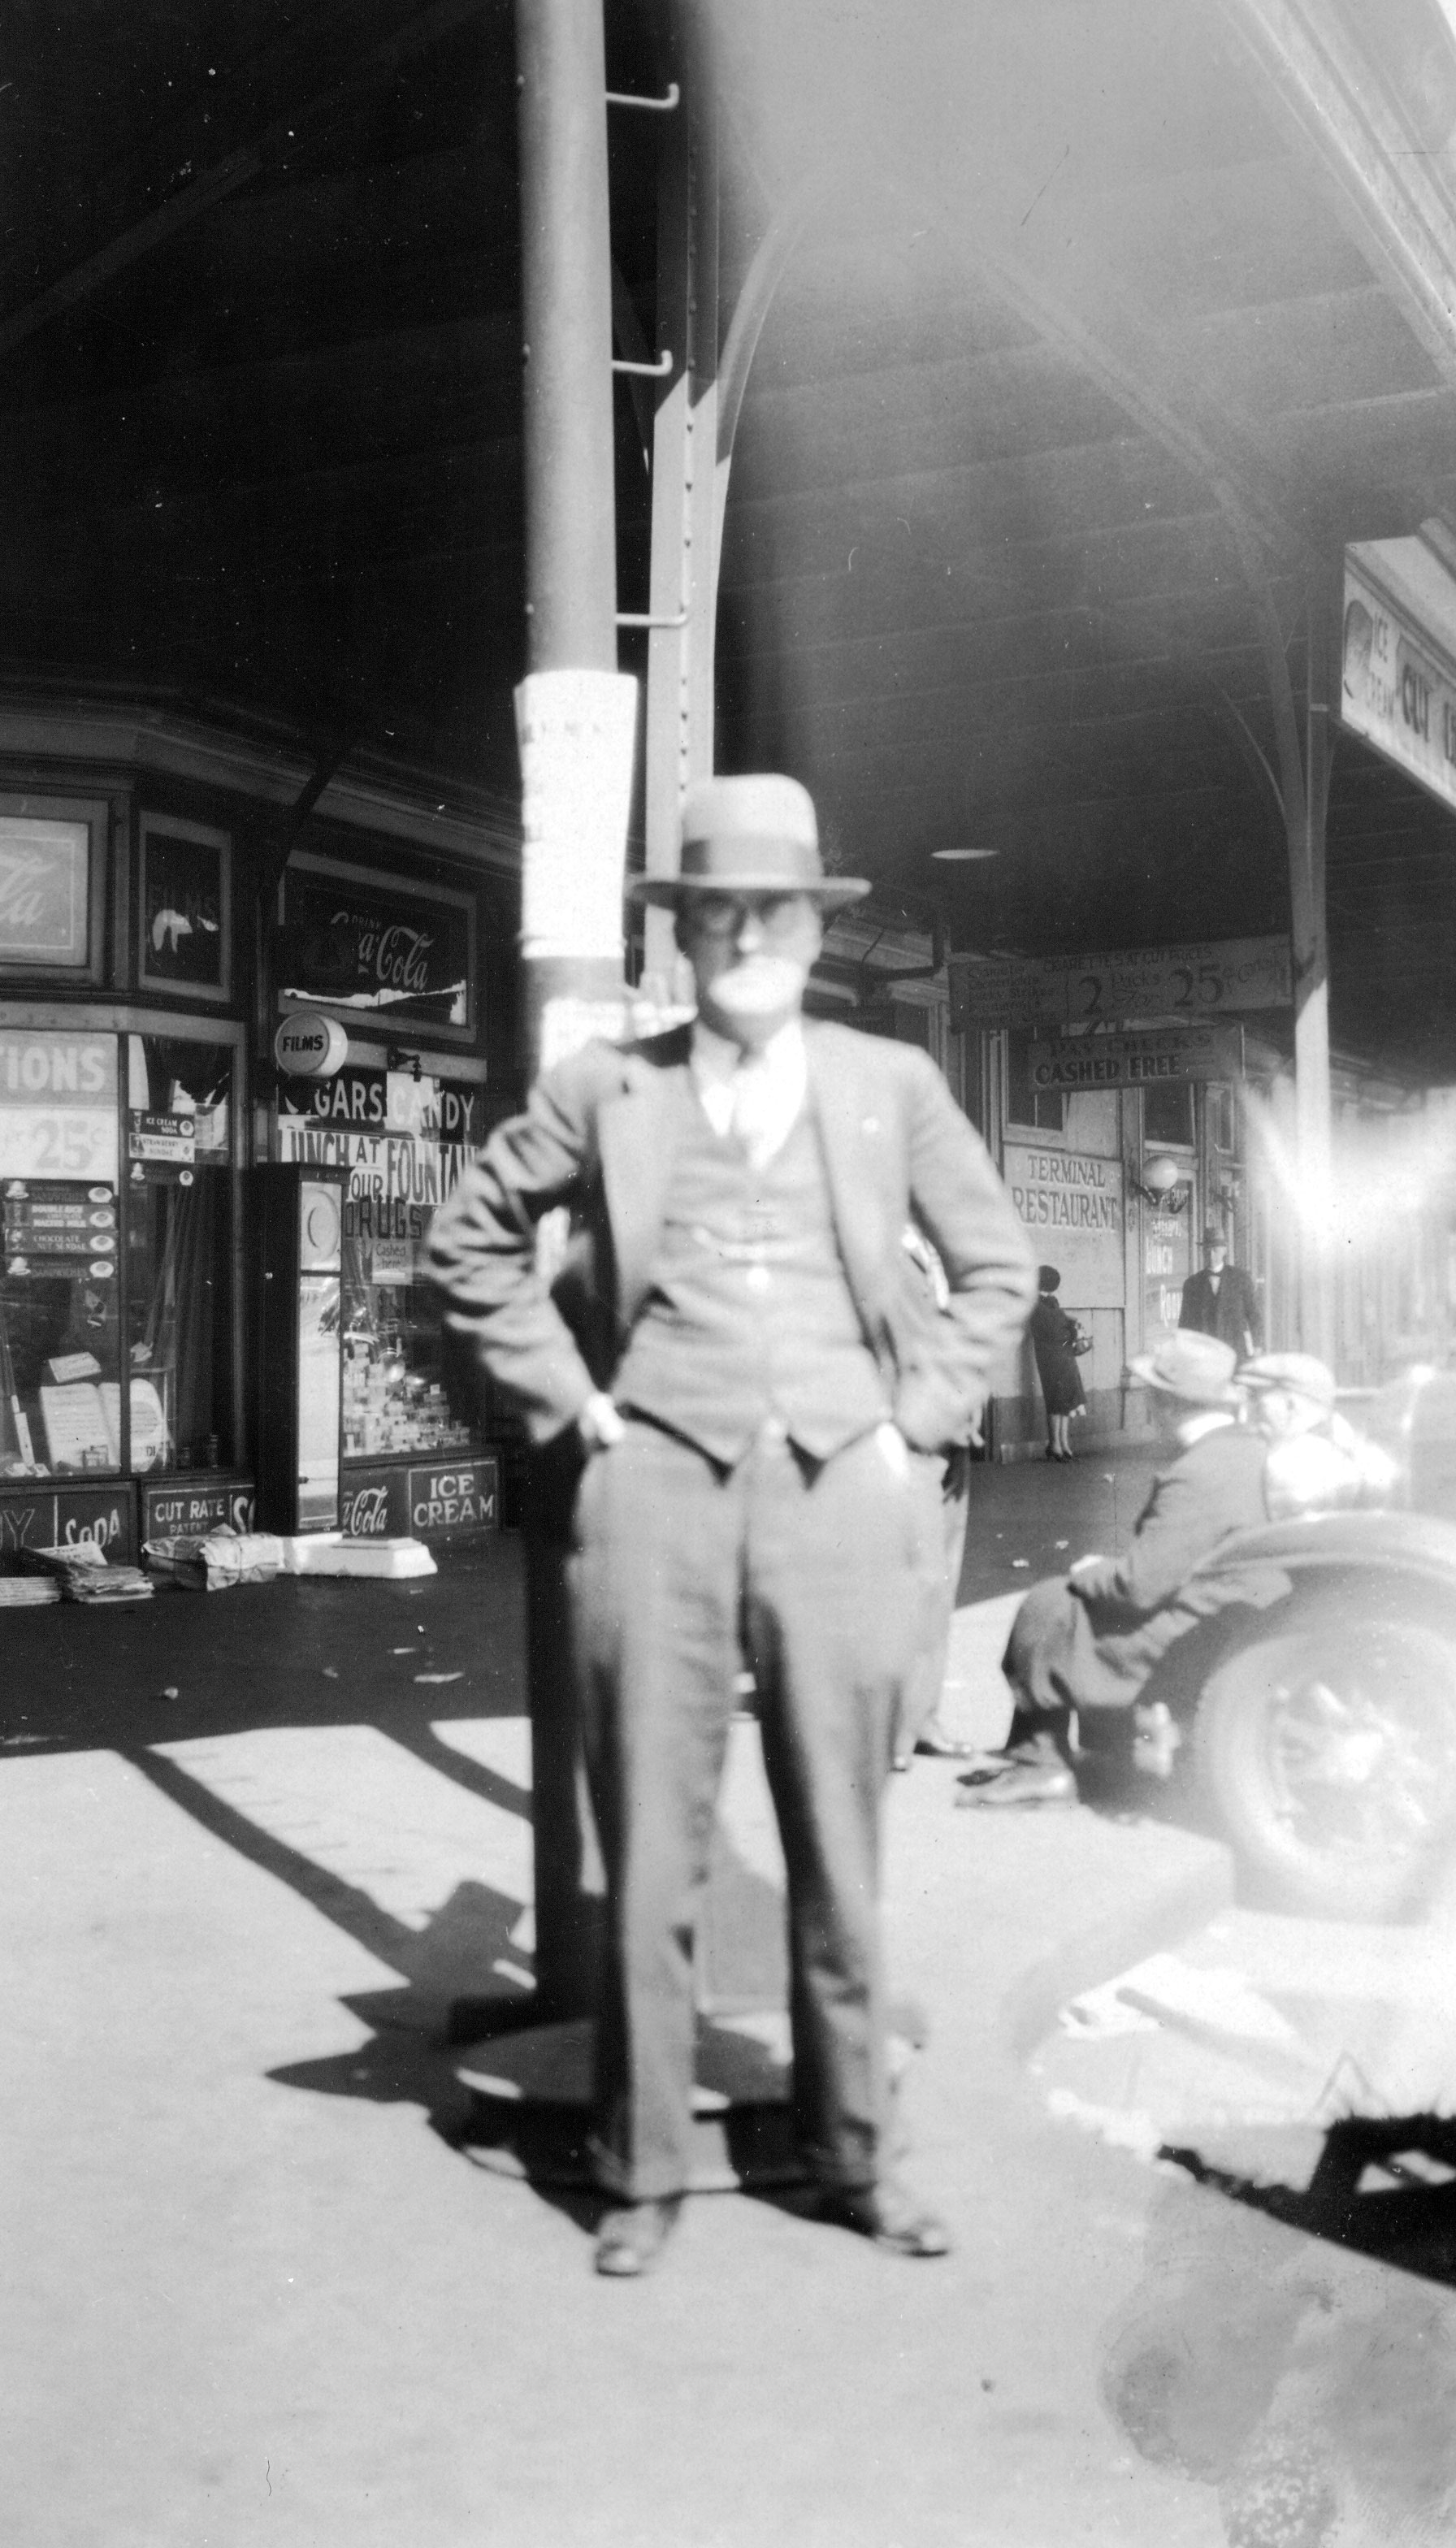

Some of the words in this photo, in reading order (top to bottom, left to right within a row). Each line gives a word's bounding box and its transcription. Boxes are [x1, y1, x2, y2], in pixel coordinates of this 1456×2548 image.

[351, 914, 382, 930] DRINK
[1078, 975, 1103, 1015] 2
[1112, 972, 1162, 989] Packs
[282, 1034, 325, 1051] FILMS
[1034, 1058, 1120, 1086] CASHED
[1129, 1055, 1181, 1079] FREE
[284, 1078, 384, 1123] GARS
[145, 1116, 155, 1125] ICE
[156, 1117, 178, 1127] CREAM
[356, 1137, 381, 1164] AT
[1027, 1155, 1106, 1188] TERMINAL
[345, 1194, 422, 1240] DRUGS
[1012, 1187, 1117, 1229] RESTAURANT
[32, 1235, 80, 1243] CHOCOLATE
[376, 1243, 406, 1257] Cashed
[429, 1473, 474, 1500] ICE
[154, 1501, 184, 1523] CUT
[188, 1498, 226, 1519] RATE
[413, 1493, 495, 1528] CREAM
